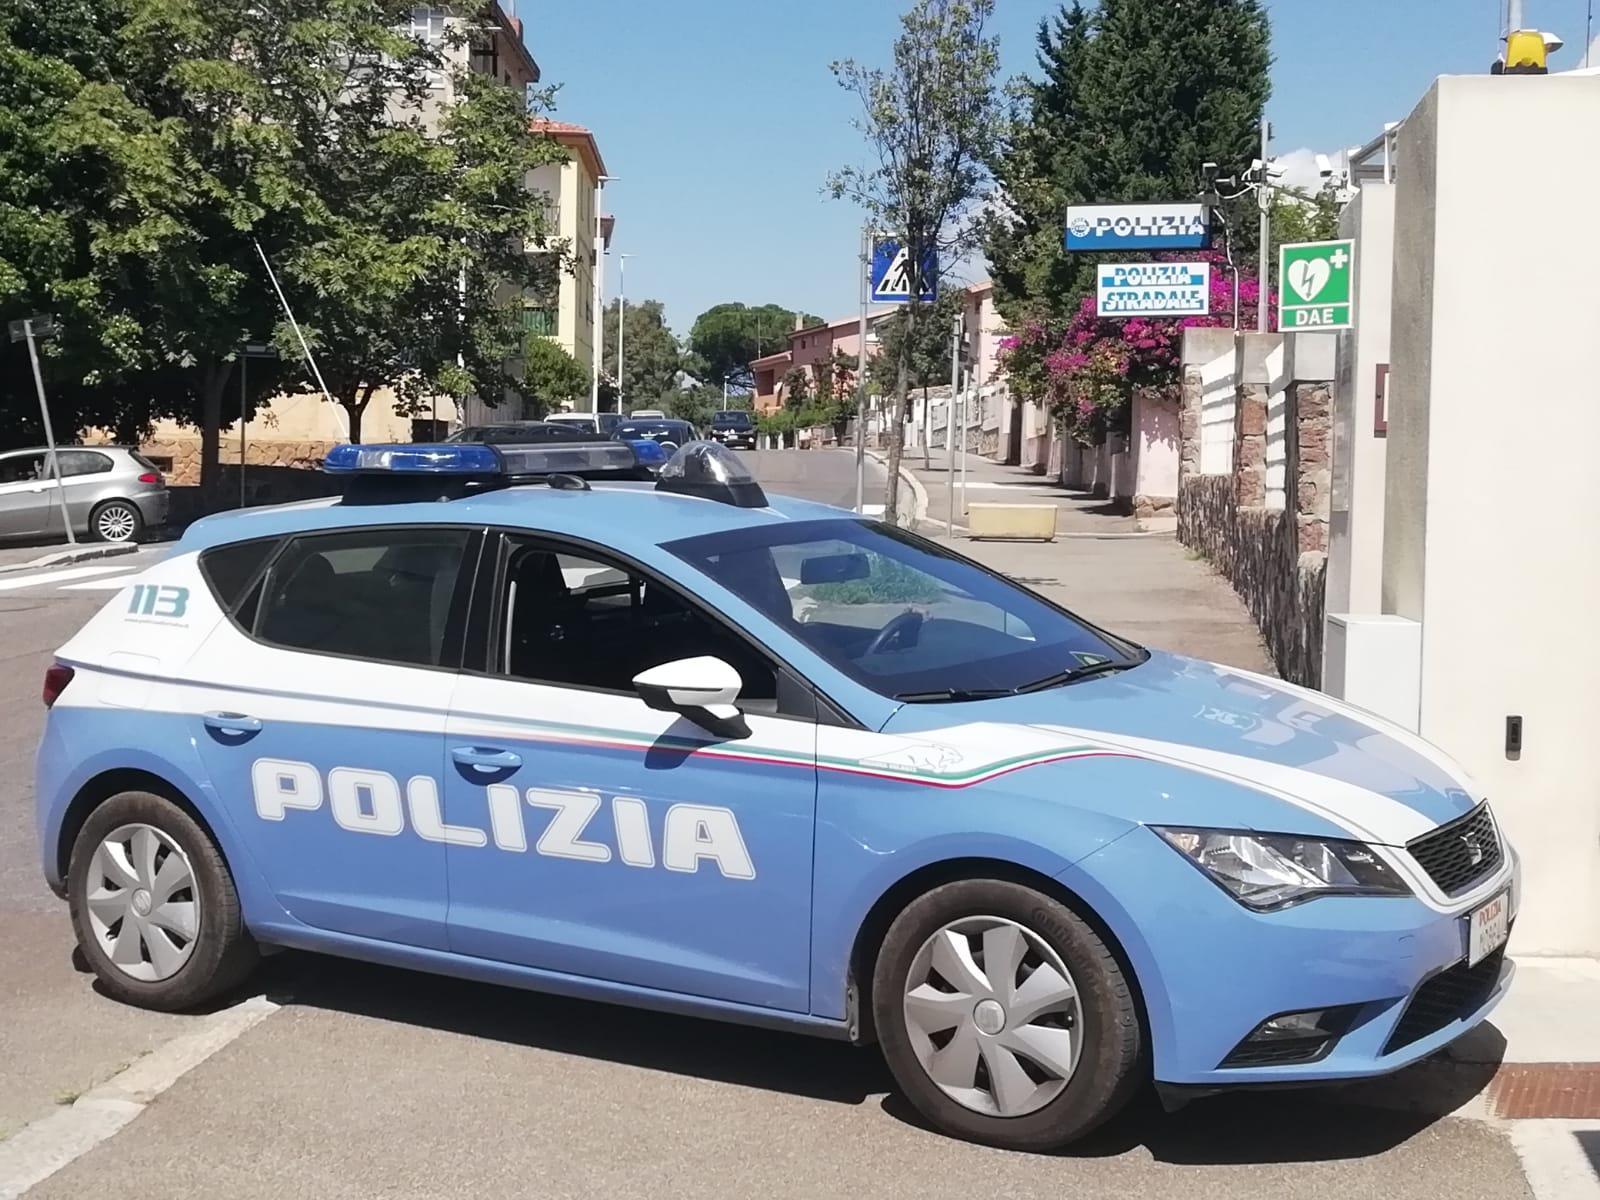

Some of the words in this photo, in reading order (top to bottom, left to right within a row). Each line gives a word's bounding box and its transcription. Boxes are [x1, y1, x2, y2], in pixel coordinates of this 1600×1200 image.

[1095, 216, 1205, 237] POLIZIA
[1114, 266, 1191, 287] POLIZIA
[1105, 290, 1203, 311] STRADALE
[1295, 308, 1334, 327] DAE
[127, 584, 189, 618] 113
[251, 757, 756, 880] POLIZIA
